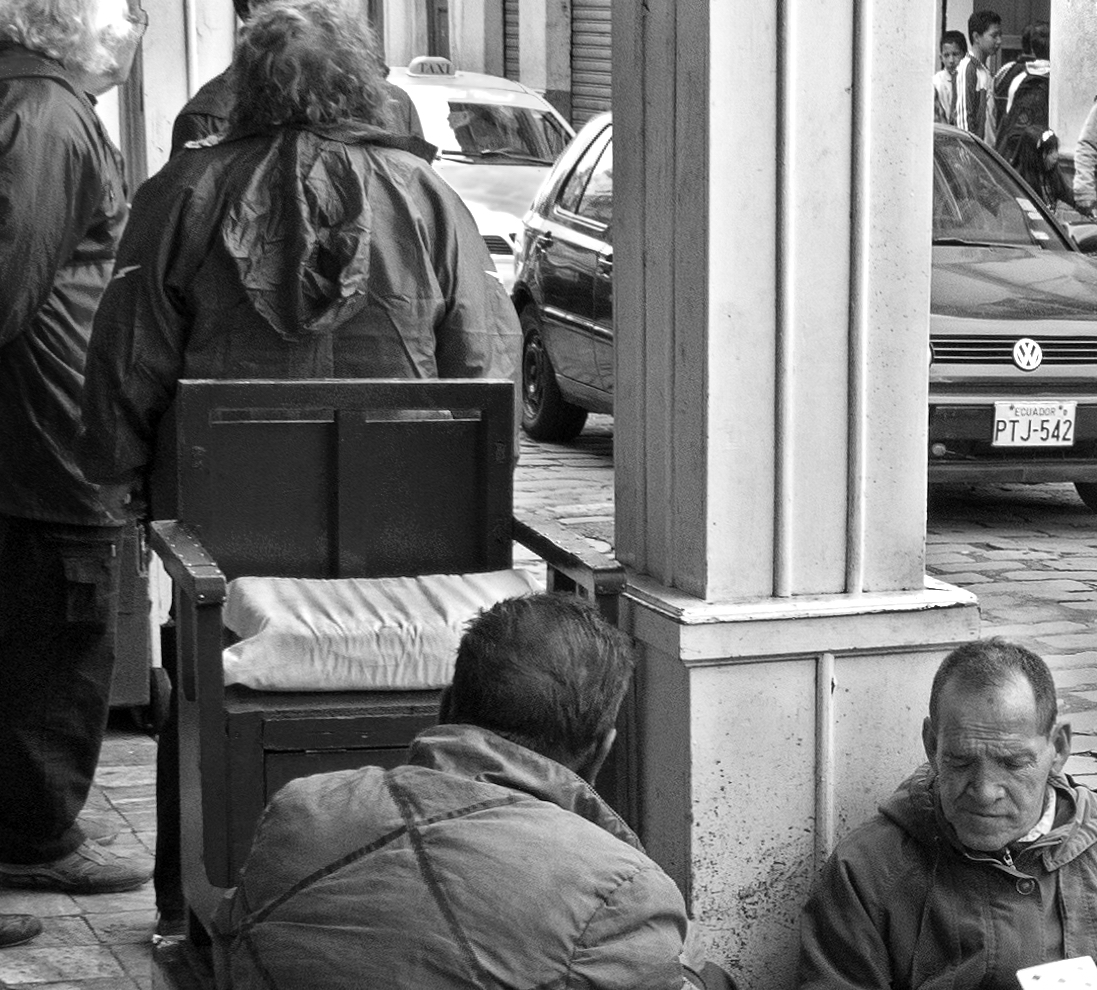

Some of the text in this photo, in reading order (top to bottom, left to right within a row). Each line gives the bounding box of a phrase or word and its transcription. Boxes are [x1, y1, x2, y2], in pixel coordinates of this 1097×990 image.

[420, 62, 451, 75] TAXI
[1014, 406, 1056, 417] ECUADOR
[995, 419, 1073, 442] PTJ-542
